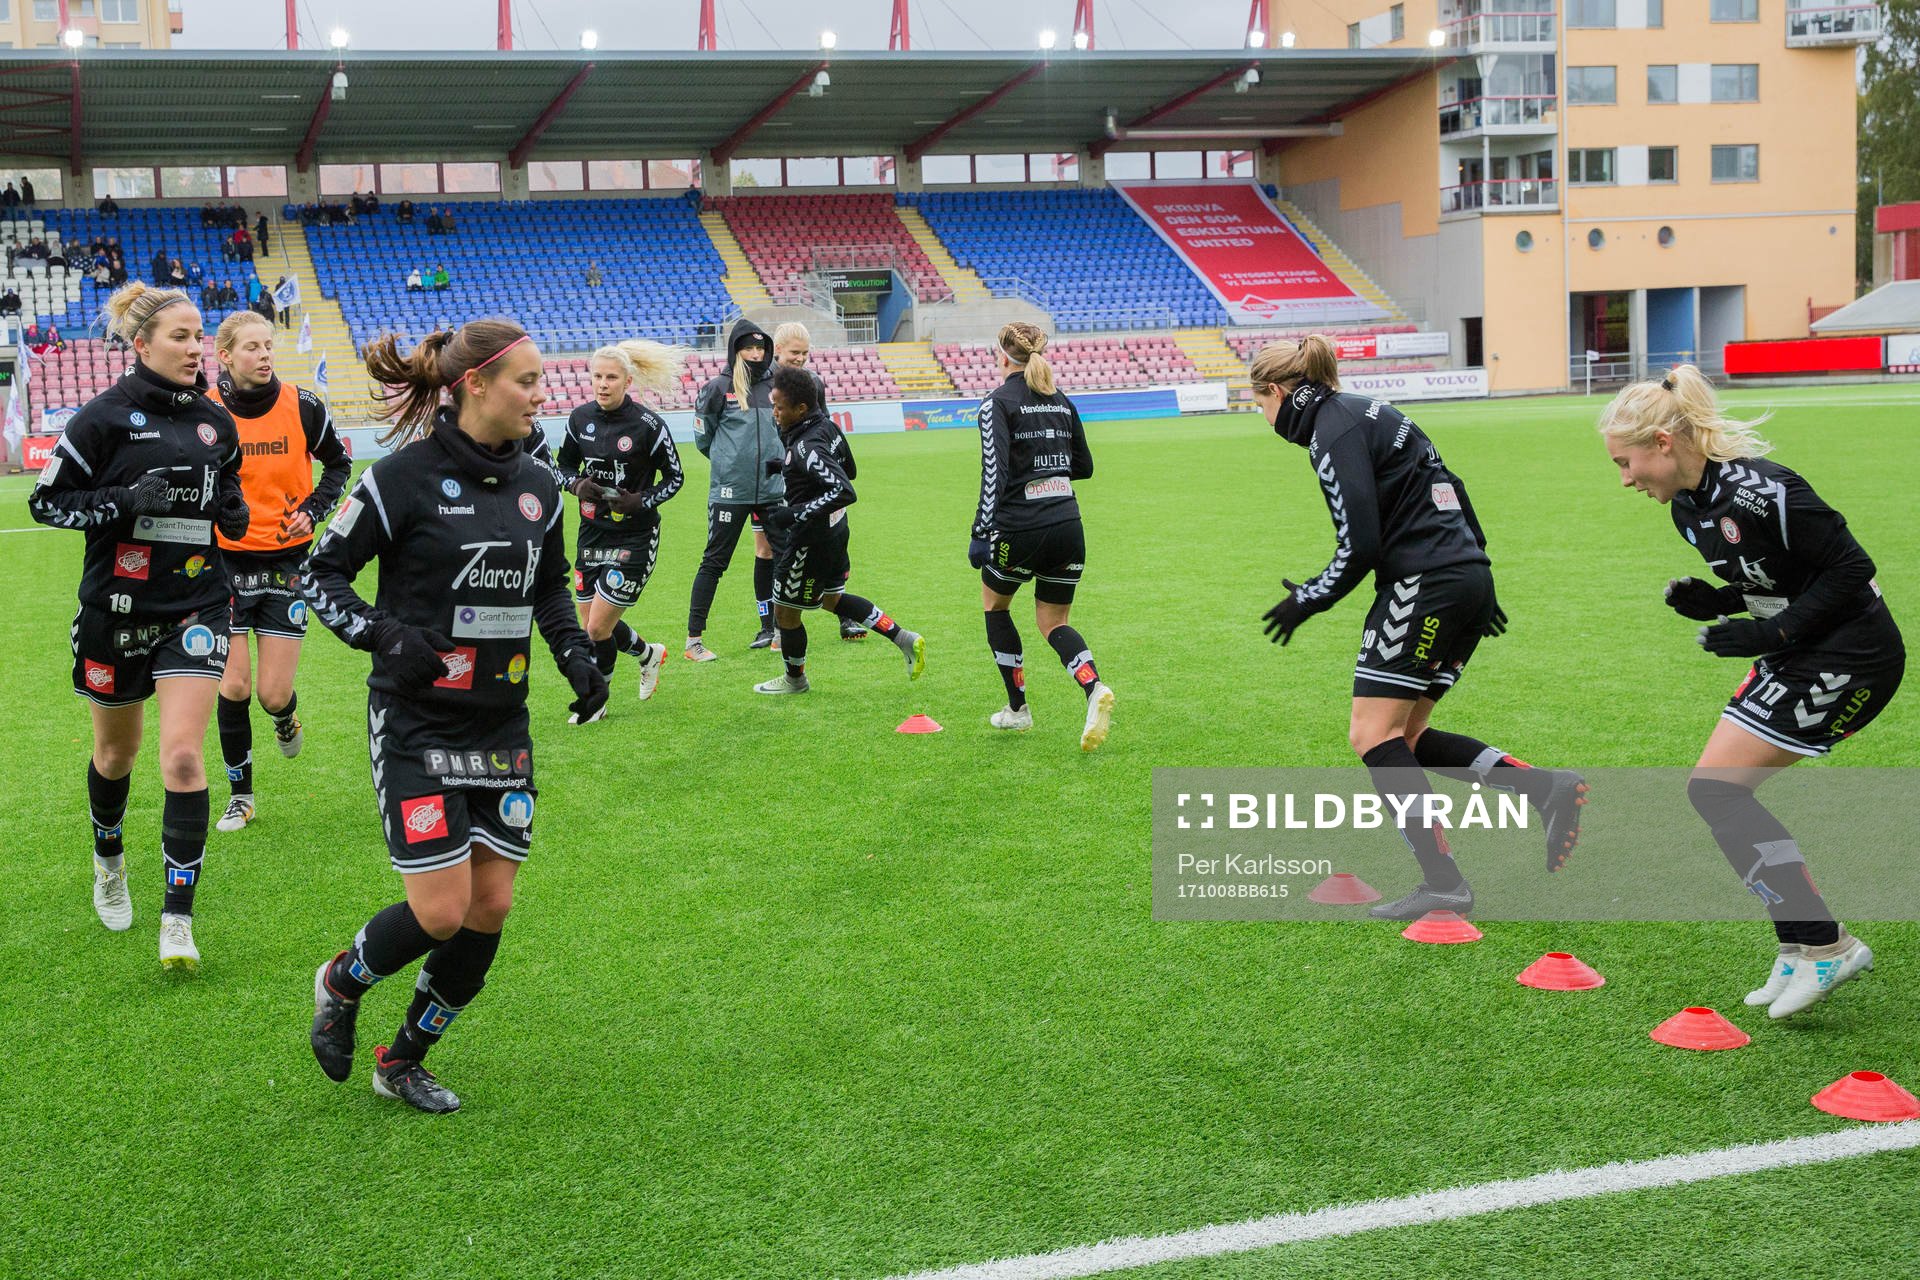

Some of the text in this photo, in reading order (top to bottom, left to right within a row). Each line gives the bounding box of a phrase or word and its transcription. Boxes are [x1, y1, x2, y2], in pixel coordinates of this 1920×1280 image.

[1153, 203, 1224, 213] SKRUVA
[1165, 214, 1242, 225] DEN SOM
[1176, 226, 1286, 236] ESKILSTUNA
[1187, 238, 1254, 248] UNITED
[1351, 378, 1406, 390] VOLVO
[1424, 375, 1478, 386] VOLVO
[923, 408, 953, 423] Tuna
[1020, 403, 1071, 416] Handelsbanken
[129, 431, 161, 440] hummel
[239, 435, 289, 456] mmel
[720, 487, 733, 499] EG
[1736, 486, 1769, 508] KIDS IN
[438, 504, 475, 515] hummel
[1733, 495, 1769, 518] MOTION
[718, 510, 732, 523] EG
[155, 520, 176, 530] Grant
[450, 541, 522, 590] Telarco
[621, 580, 637, 593] 23
[110, 593, 132, 614] 19
[478, 611, 501, 622] Grant
[215, 633, 229, 656] 19
[1415, 616, 1440, 660] PLUS
[1760, 681, 1788, 706] 17
[1740, 695, 1773, 721] hummel
[1830, 687, 1872, 735] PLUS
